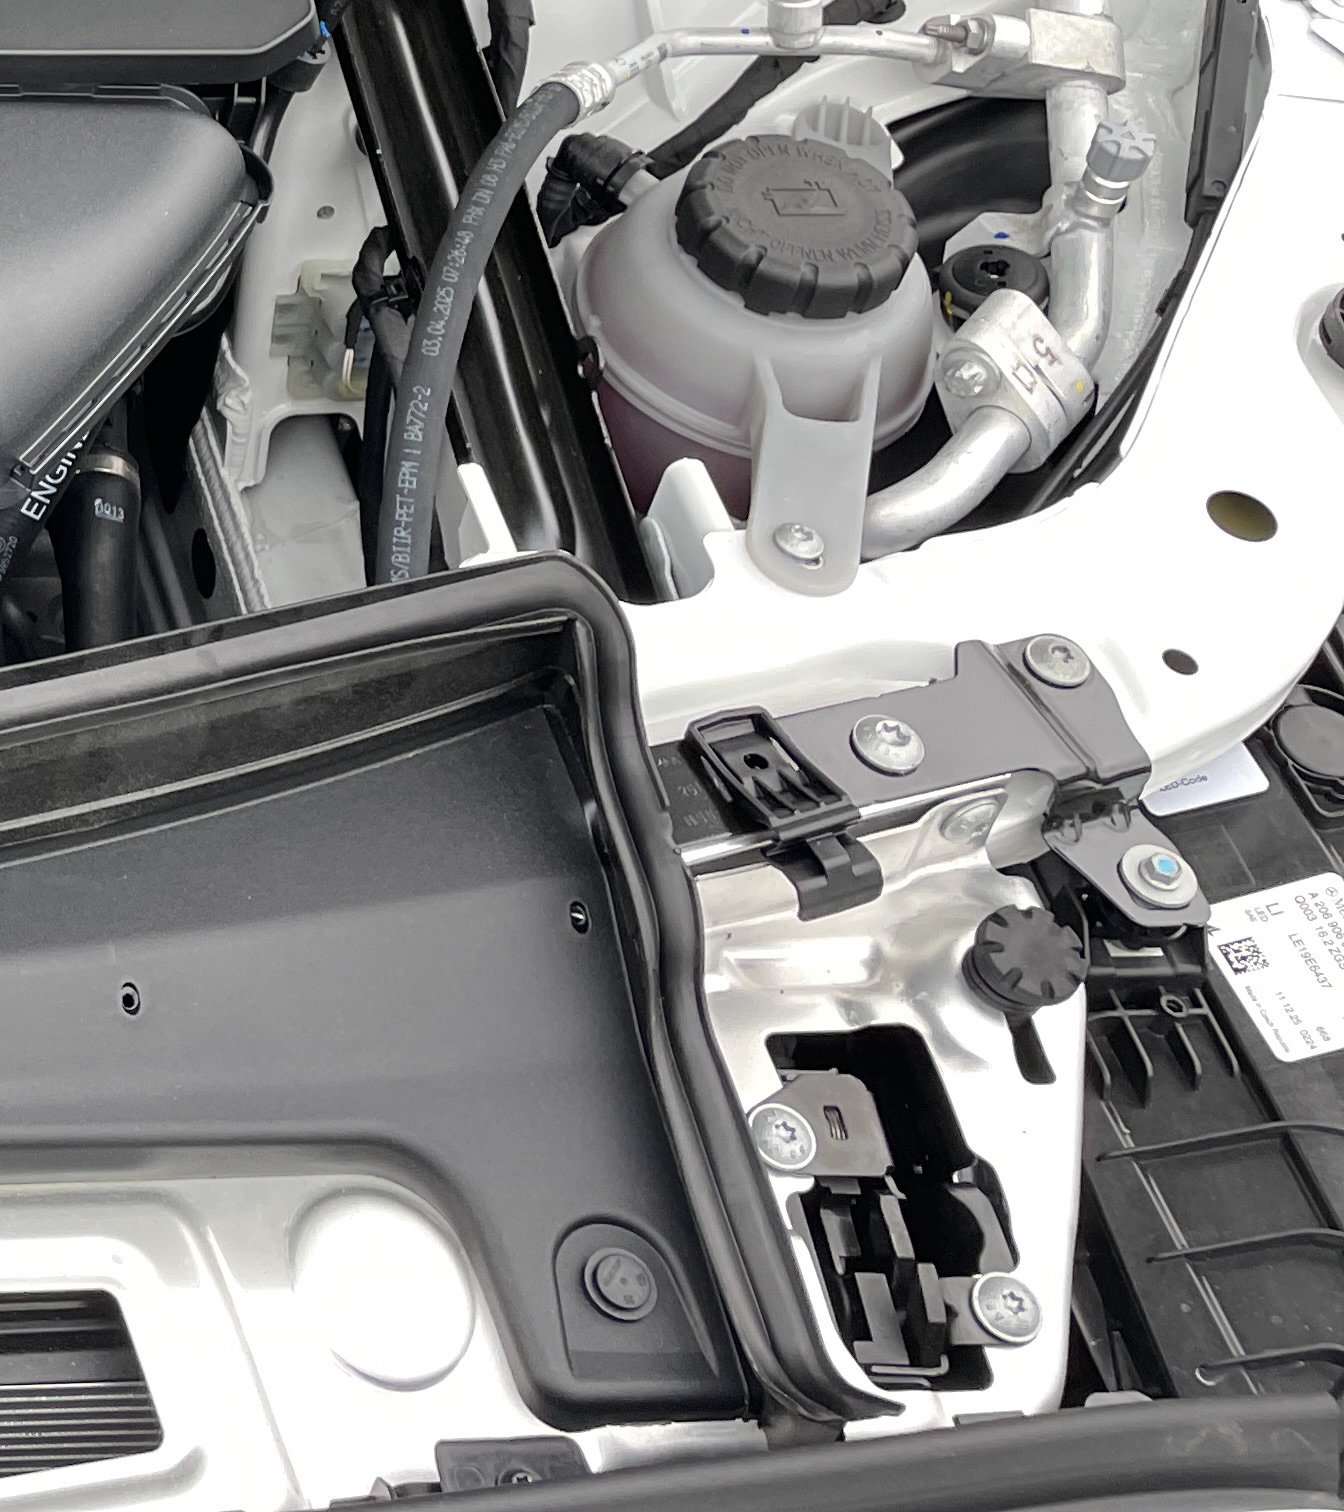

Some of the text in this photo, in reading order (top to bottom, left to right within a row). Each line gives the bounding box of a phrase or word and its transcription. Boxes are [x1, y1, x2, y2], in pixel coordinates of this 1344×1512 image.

[421, 285, 456, 357] 03.04.2025
[1254, 907, 1269, 922] LED
[1294, 895, 1318, 922] Q003
[1314, 900, 1334, 921] 206
[1288, 932, 1333, 989] LE19E6437
